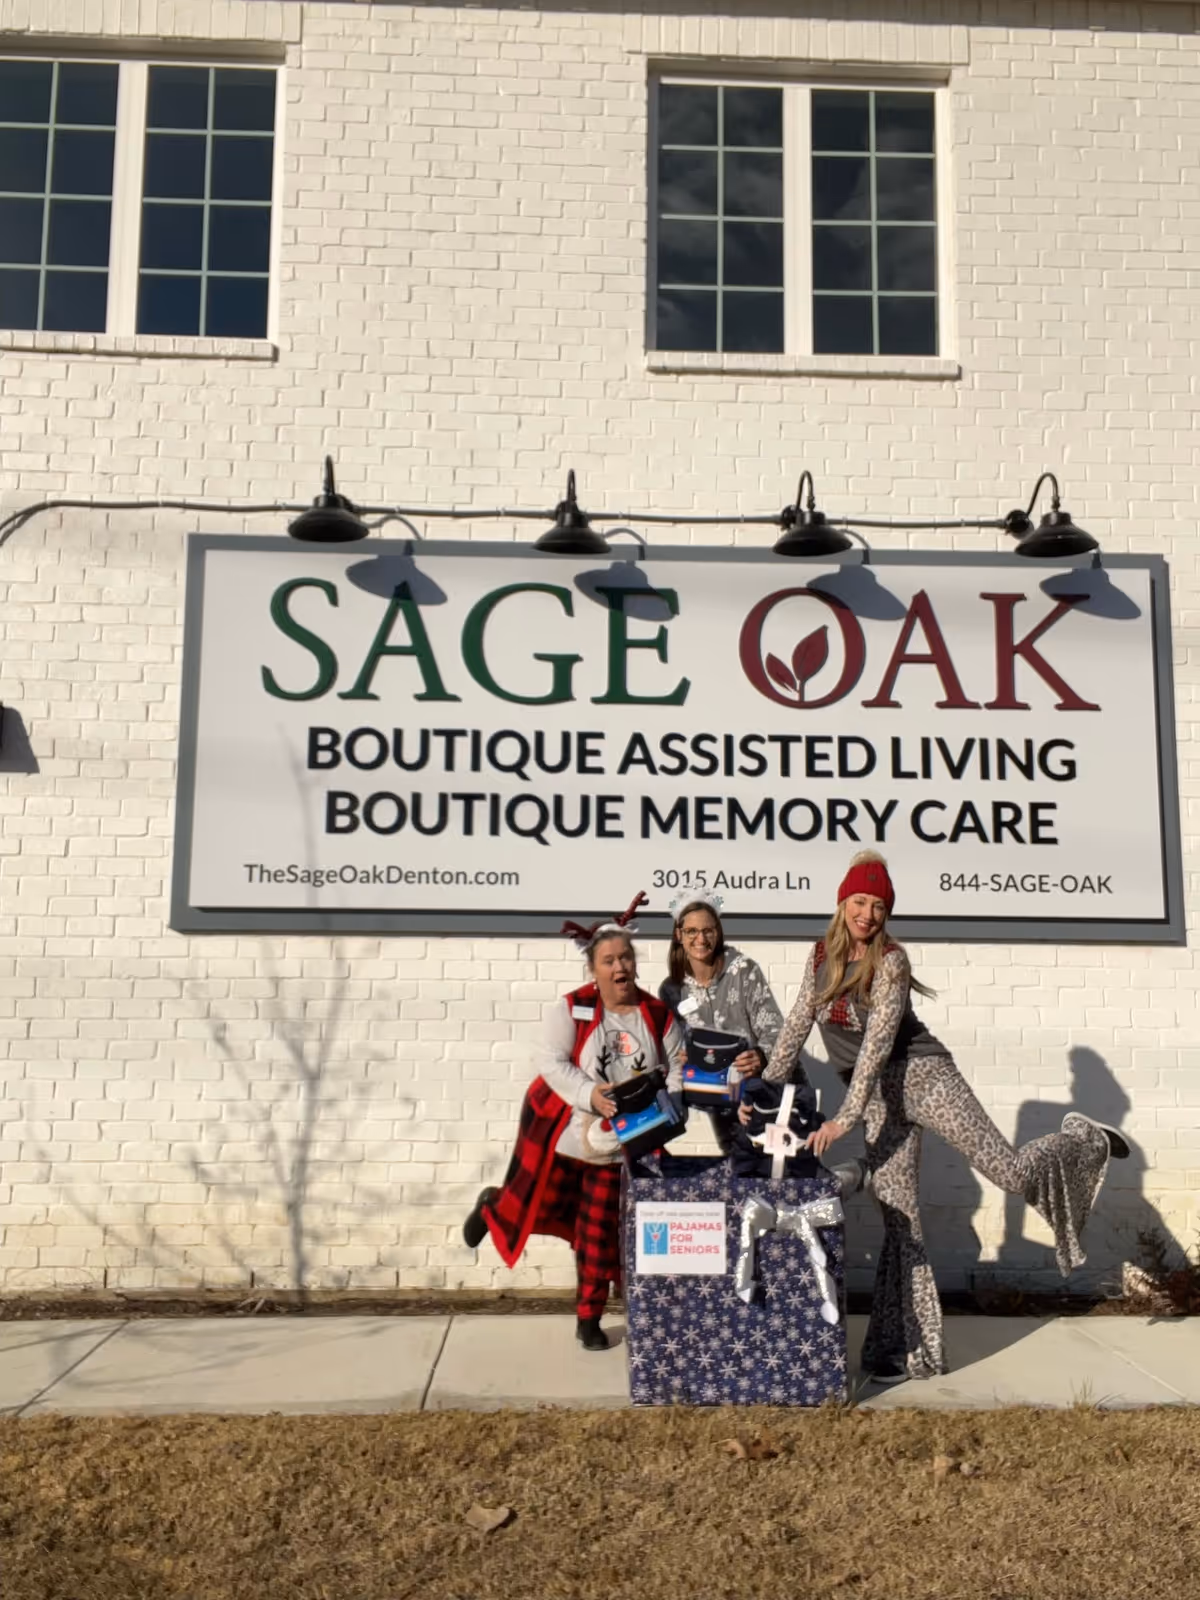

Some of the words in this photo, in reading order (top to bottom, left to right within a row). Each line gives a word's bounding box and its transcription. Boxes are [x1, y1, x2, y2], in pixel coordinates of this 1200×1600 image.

[261, 577, 691, 706] SAGE
[739, 586, 1101, 712] OAK
[307, 726, 605, 781] BOUTIQUE
[617, 732, 877, 779] ASSISTED
[891, 736, 1077, 782] LIVING
[325, 790, 624, 846] BOUTIQUE
[641, 796, 899, 843] MEMORY
[910, 799, 1059, 845] CARE
[244, 863, 520, 888] TheSageOakDenton.com
[652, 869, 707, 889] 3015
[713, 870, 780, 889] Audra
[786, 871, 811, 890] Ln
[939, 872, 1113, 895] 844-SAGE-OAK
[670, 1222, 722, 1231] PAJAMAS
[670, 1234, 693, 1243] FOR
[670, 1245, 720, 1255] SENIORS
